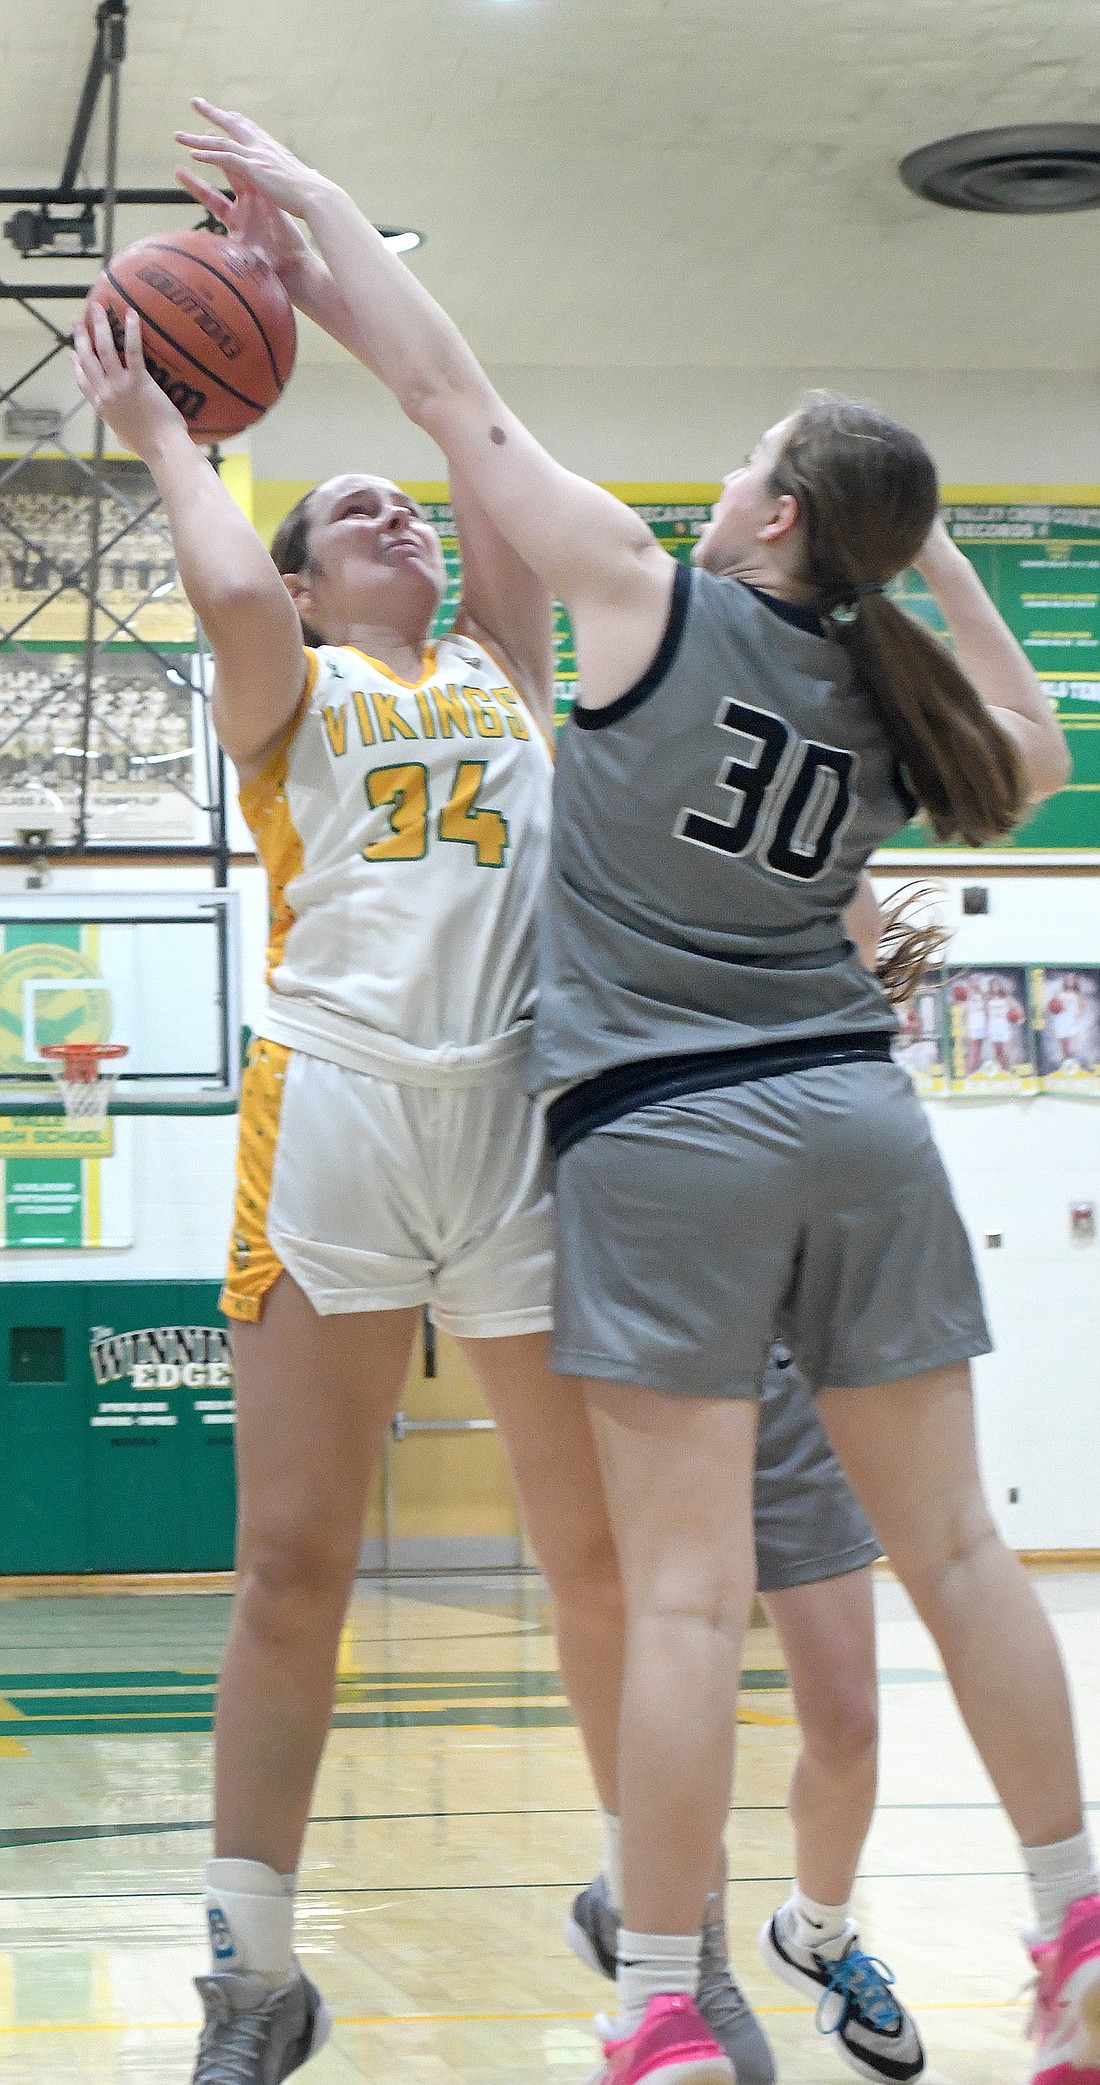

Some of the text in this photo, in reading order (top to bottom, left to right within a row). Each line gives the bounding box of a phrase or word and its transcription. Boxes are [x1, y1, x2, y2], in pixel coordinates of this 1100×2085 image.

[322, 684, 530, 757] VIKINGS
[363, 759, 509, 869] 34
[672, 696, 861, 882] 30
[32, 1130, 105, 1144] SCHOOL
[90, 1326, 232, 1385] WINNIN
[131, 1362, 235, 1390] EDGE
